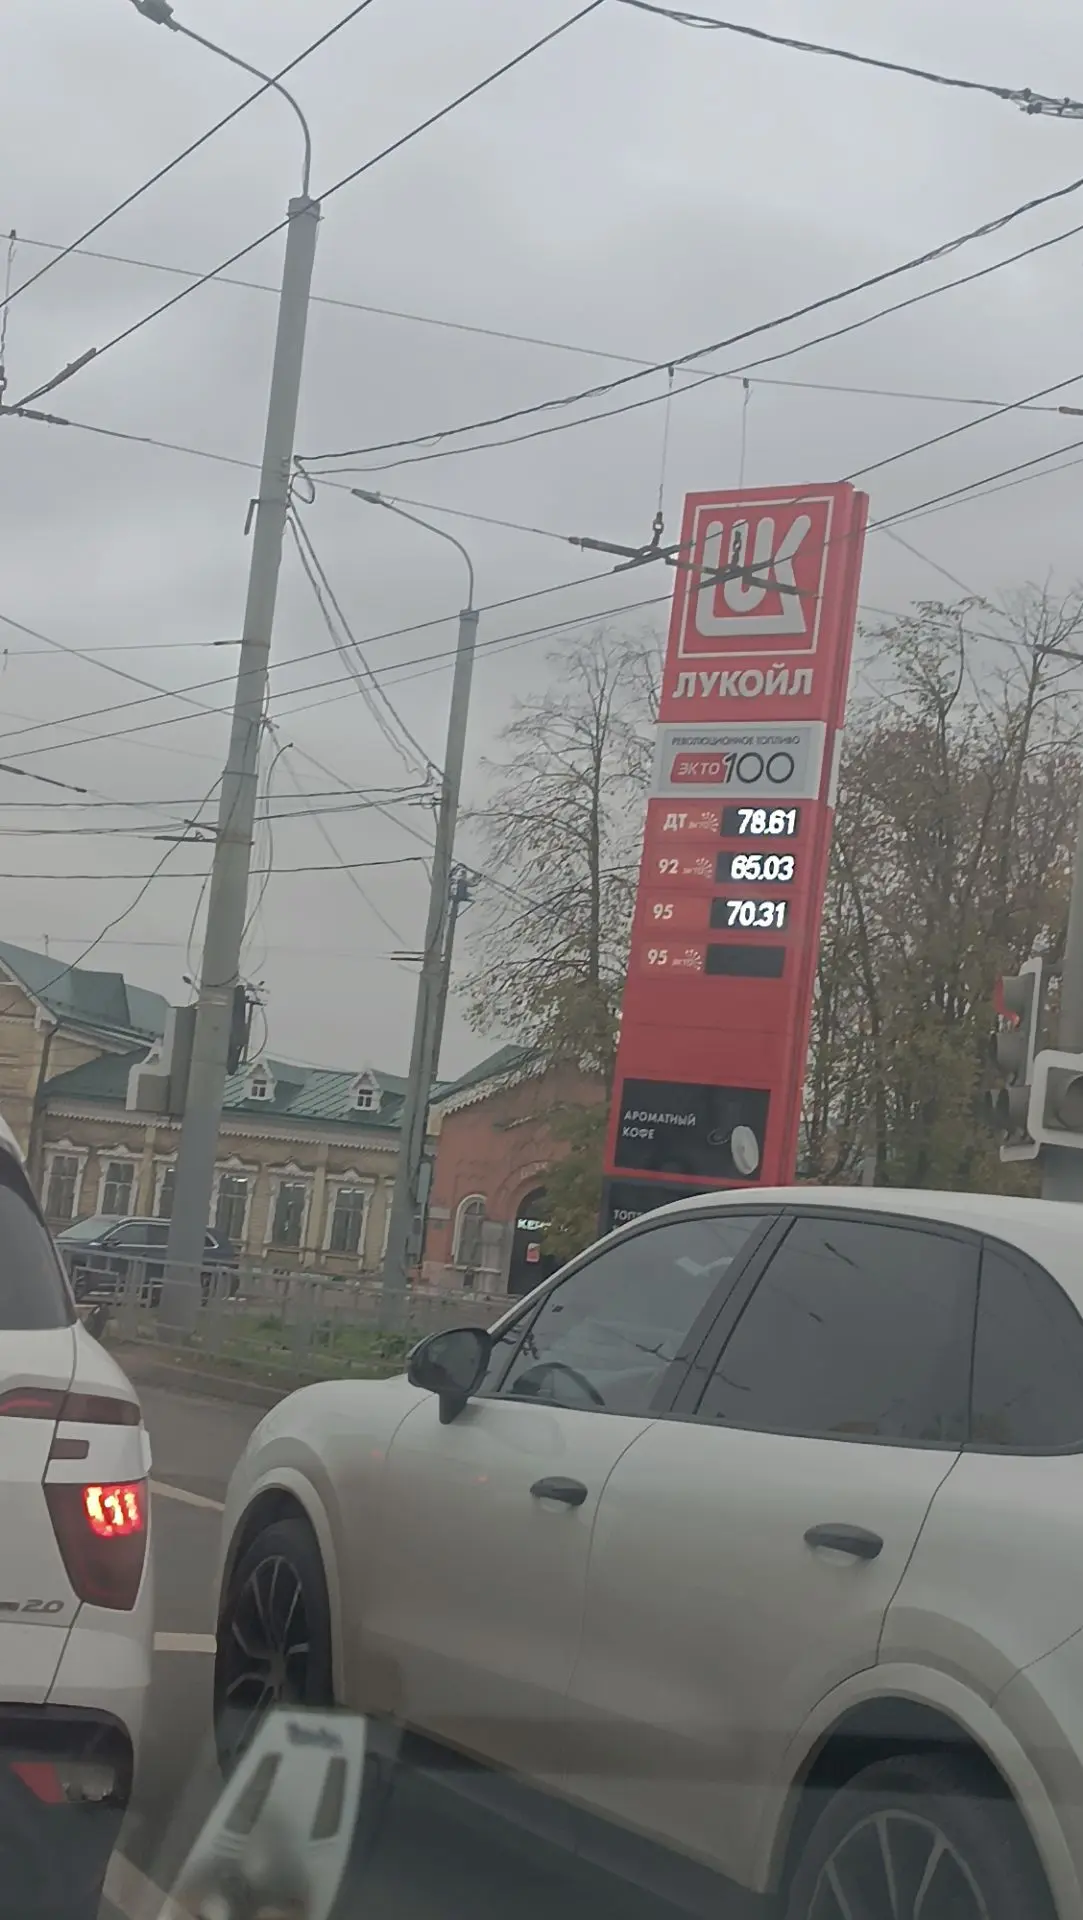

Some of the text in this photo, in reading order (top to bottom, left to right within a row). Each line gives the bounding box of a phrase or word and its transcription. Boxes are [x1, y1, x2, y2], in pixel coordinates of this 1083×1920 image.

[672, 662, 814, 698] ЛУКОЙЛ
[677, 751, 795, 784] ЭКТО 100
[663, 813, 688, 832] ДТ
[737, 808, 797, 836] 78.61
[658, 858, 679, 874] 92
[730, 854, 795, 881] 65.03
[653, 900, 786, 928] 95 70.31
[647, 948, 668, 965] 95
[623, 1110, 696, 1126] АРОМАТНЫЙ
[622, 1126, 655, 1140] КОФЕ
